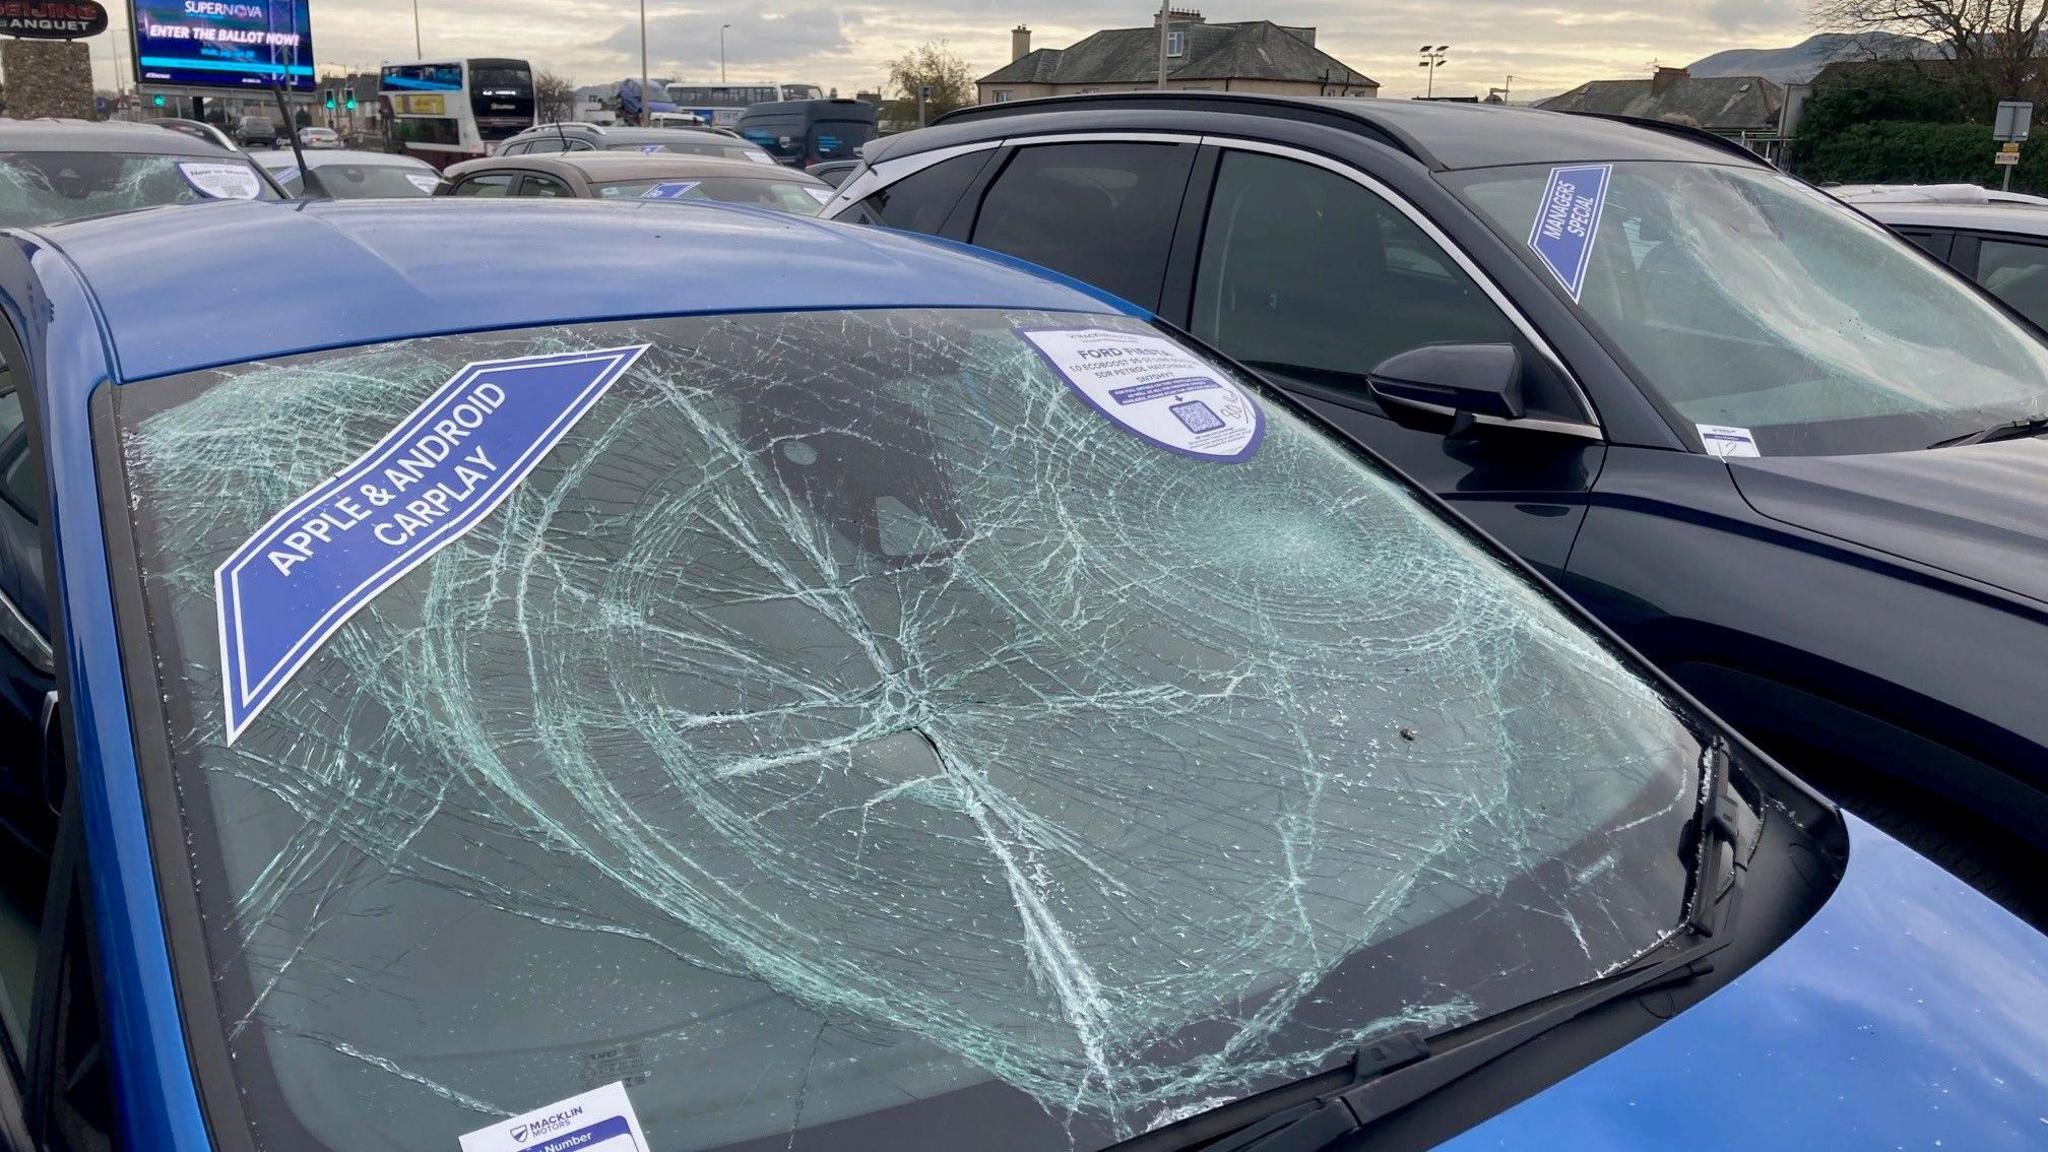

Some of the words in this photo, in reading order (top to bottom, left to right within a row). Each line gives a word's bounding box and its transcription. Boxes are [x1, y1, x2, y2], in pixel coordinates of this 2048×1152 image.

[185, 1, 262, 19] SUPERNOVA
[150, 25, 190, 38] ENTER
[192, 27, 216, 41] THE
[218, 29, 265, 44] BALLOT
[266, 33, 299, 46] NOW!
[1543, 180, 1576, 240] MANAGERS
[1567, 195, 1594, 238] SPECIAL
[1077, 347, 1122, 360] FORD
[1114, 366, 1147, 376] PETROL
[267, 489, 373, 577] APPLE
[363, 483, 395, 508] &
[383, 382, 506, 493] ANDROID
[373, 445, 498, 547] CARPLAY
[529, 1106, 583, 1131] MACKLIN
[532, 1119, 571, 1137] MOTORS
[544, 1132, 592, 1152] Number
